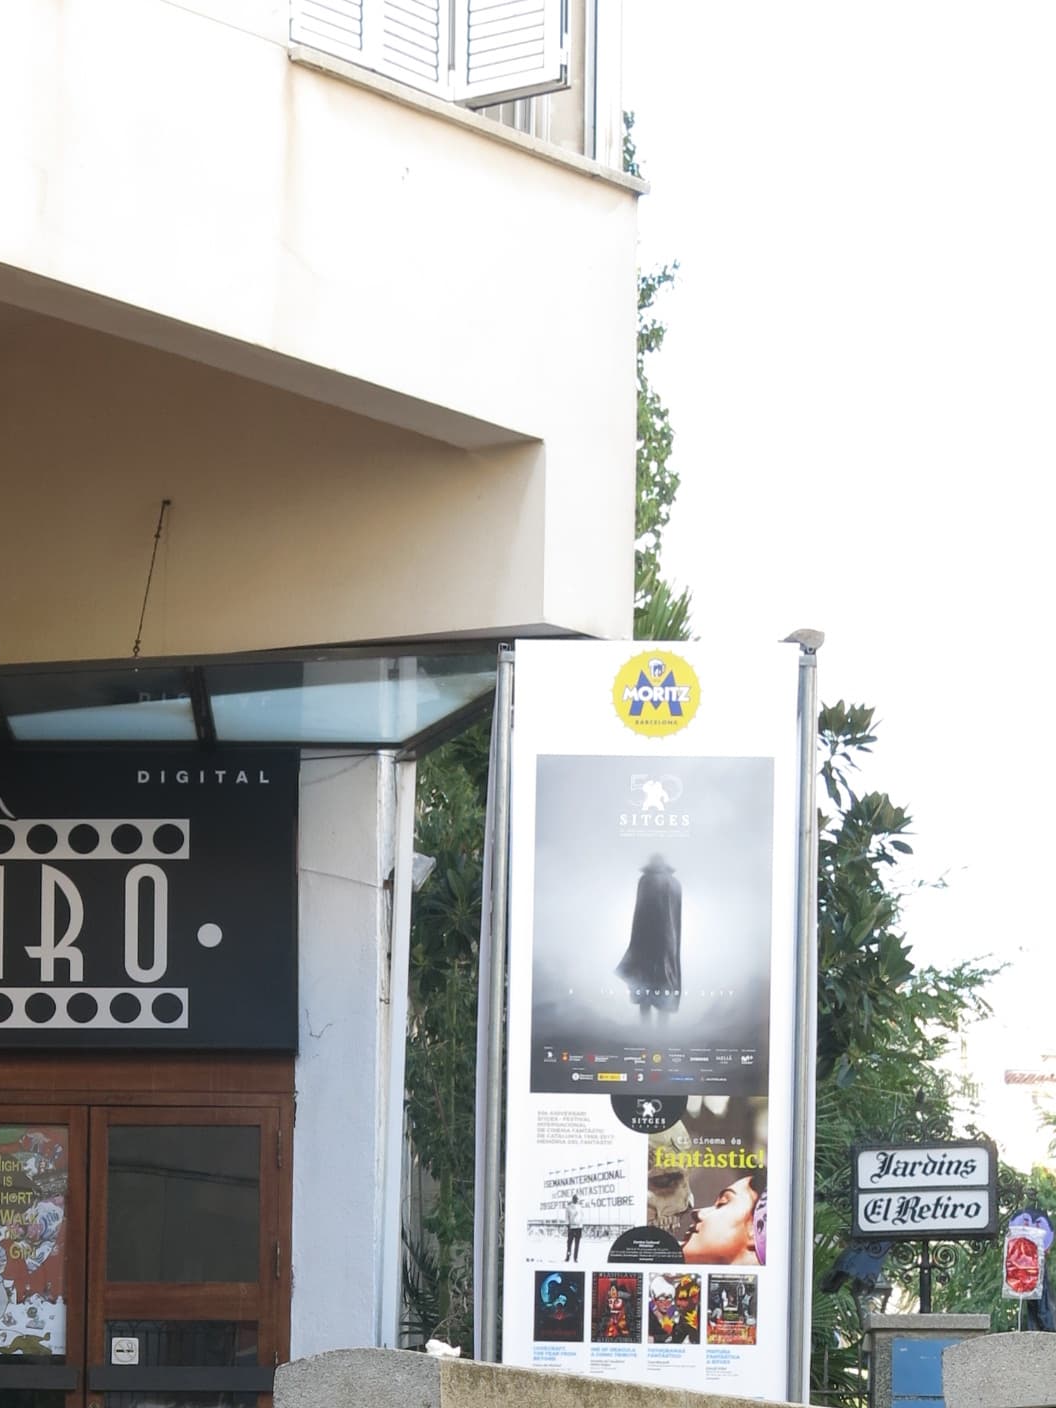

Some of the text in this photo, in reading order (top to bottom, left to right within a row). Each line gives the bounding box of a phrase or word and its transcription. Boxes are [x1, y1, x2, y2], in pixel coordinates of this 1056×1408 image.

[622, 686, 692, 702] MORITZ
[137, 769, 270, 784] DIGITAL
[618, 813, 691, 827] SITGES
[631, 1117, 666, 1125] SITGES
[693, 1136, 726, 1145] cinema
[730, 1136, 742, 1145] és
[653, 1145, 765, 1169] fantàstic!
[870, 1151, 977, 1184] Jardins
[596, 1195, 635, 1207] OCTUBRE
[863, 1195, 982, 1225] El Retiro
